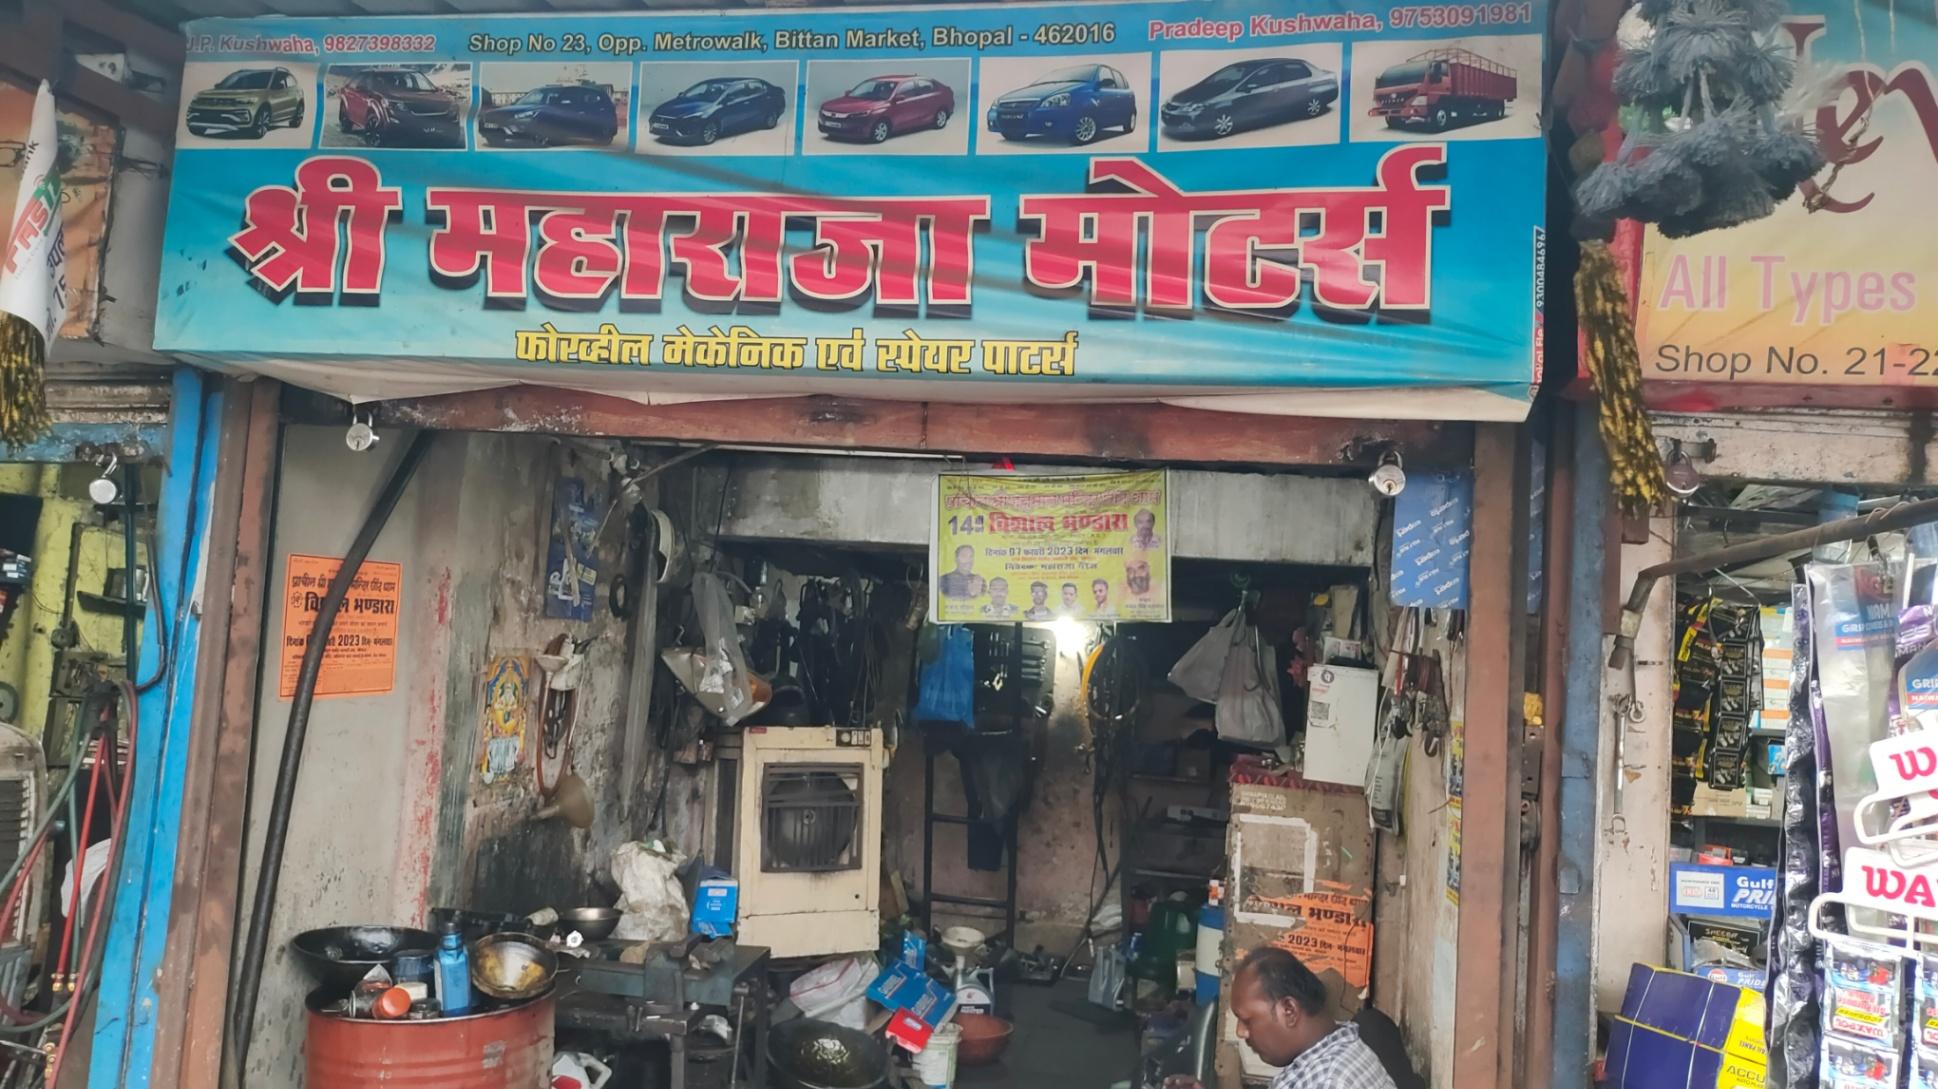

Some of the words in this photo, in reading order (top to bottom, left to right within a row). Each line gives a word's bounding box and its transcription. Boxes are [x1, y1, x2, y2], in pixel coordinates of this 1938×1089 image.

[1148, 19, 1244, 42] Pradeep
[1249, 12, 1383, 36] Kushwaha,
[1389, 2, 1532, 28] 9753091981
[219, 35, 320, 56] Kushwaha,
[323, 34, 436, 52] 9827398332
[469, 34, 522, 54] Shop
[528, 33, 556, 51] No
[562, 33, 592, 54] 23,
[598, 33, 648, 55] Opp.
[653, 31, 769, 51] Metrowalk,
[774, 28, 839, 49] Bittan
[845, 27, 925, 50] Market,
[932, 25, 1013, 50] Bhopal
[1033, 22, 1116, 44] 462016
[227, 155, 403, 302] श्री
[426, 187, 991, 316] महाराजा
[1018, 142, 1451, 320] मोटर्स
[1659, 253, 1728, 312] All
[1749, 254, 1918, 326] Types
[662, 323, 808, 369] मेकेनिक
[815, 327, 866, 371] एवं
[875, 328, 976, 374] स्पेयर
[1655, 344, 1752, 381] Shop
[1766, 346, 1828, 375] No.
[988, 511, 1055, 534] विशाल
[1062, 512, 1129, 533] भण्डारा
[1047, 546, 1073, 556] 2023
[354, 598, 395, 615] भण्डारा
[338, 634, 360, 647] 2023
[1288, 934, 1318, 947] 2023
